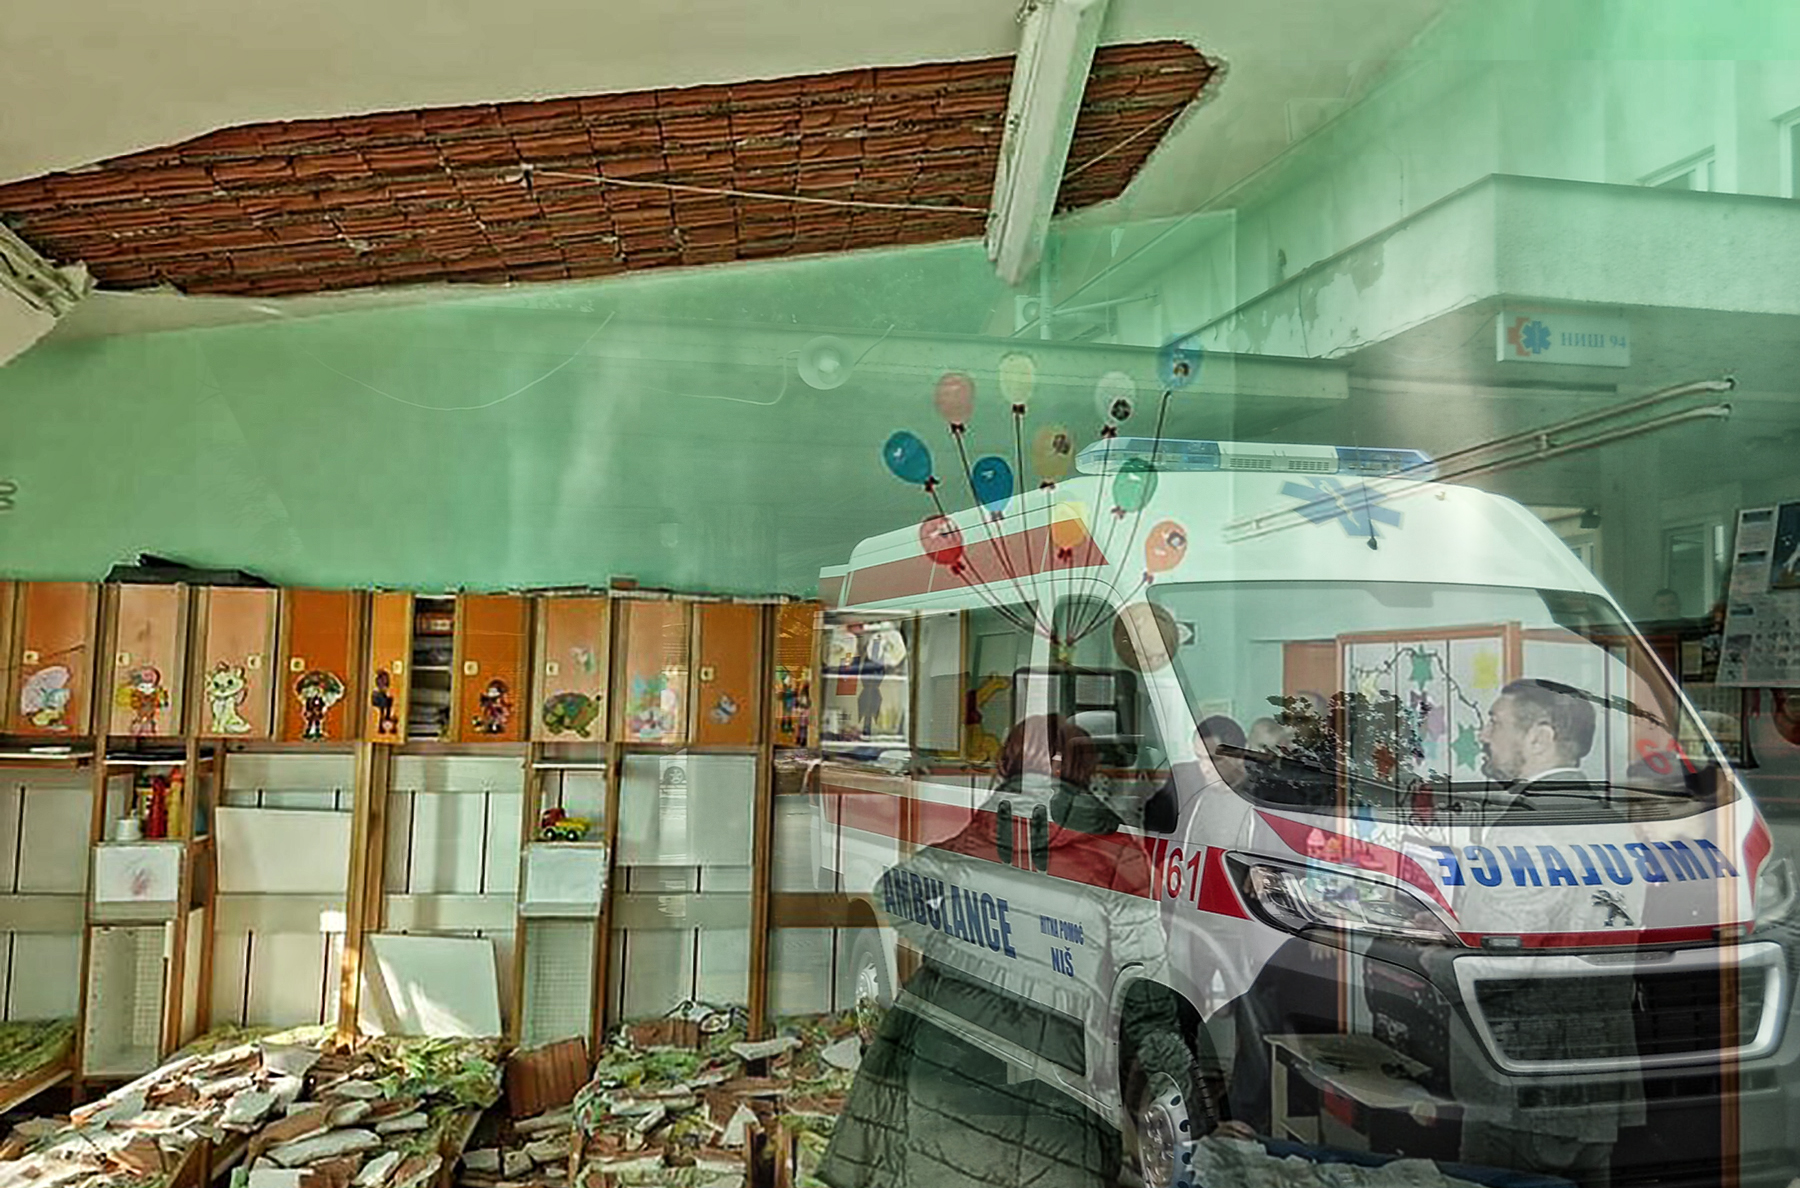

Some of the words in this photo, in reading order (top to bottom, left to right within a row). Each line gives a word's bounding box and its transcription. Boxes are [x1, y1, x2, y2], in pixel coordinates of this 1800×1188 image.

[1560, 332, 1605, 348] НИШ
[1609, 335, 1627, 349] 94
[1635, 738, 1698, 775] 61
[1167, 847, 1202, 902] 61
[882, 865, 1017, 959] AMBULANCE
[1051, 945, 1075, 978] NIŠ
